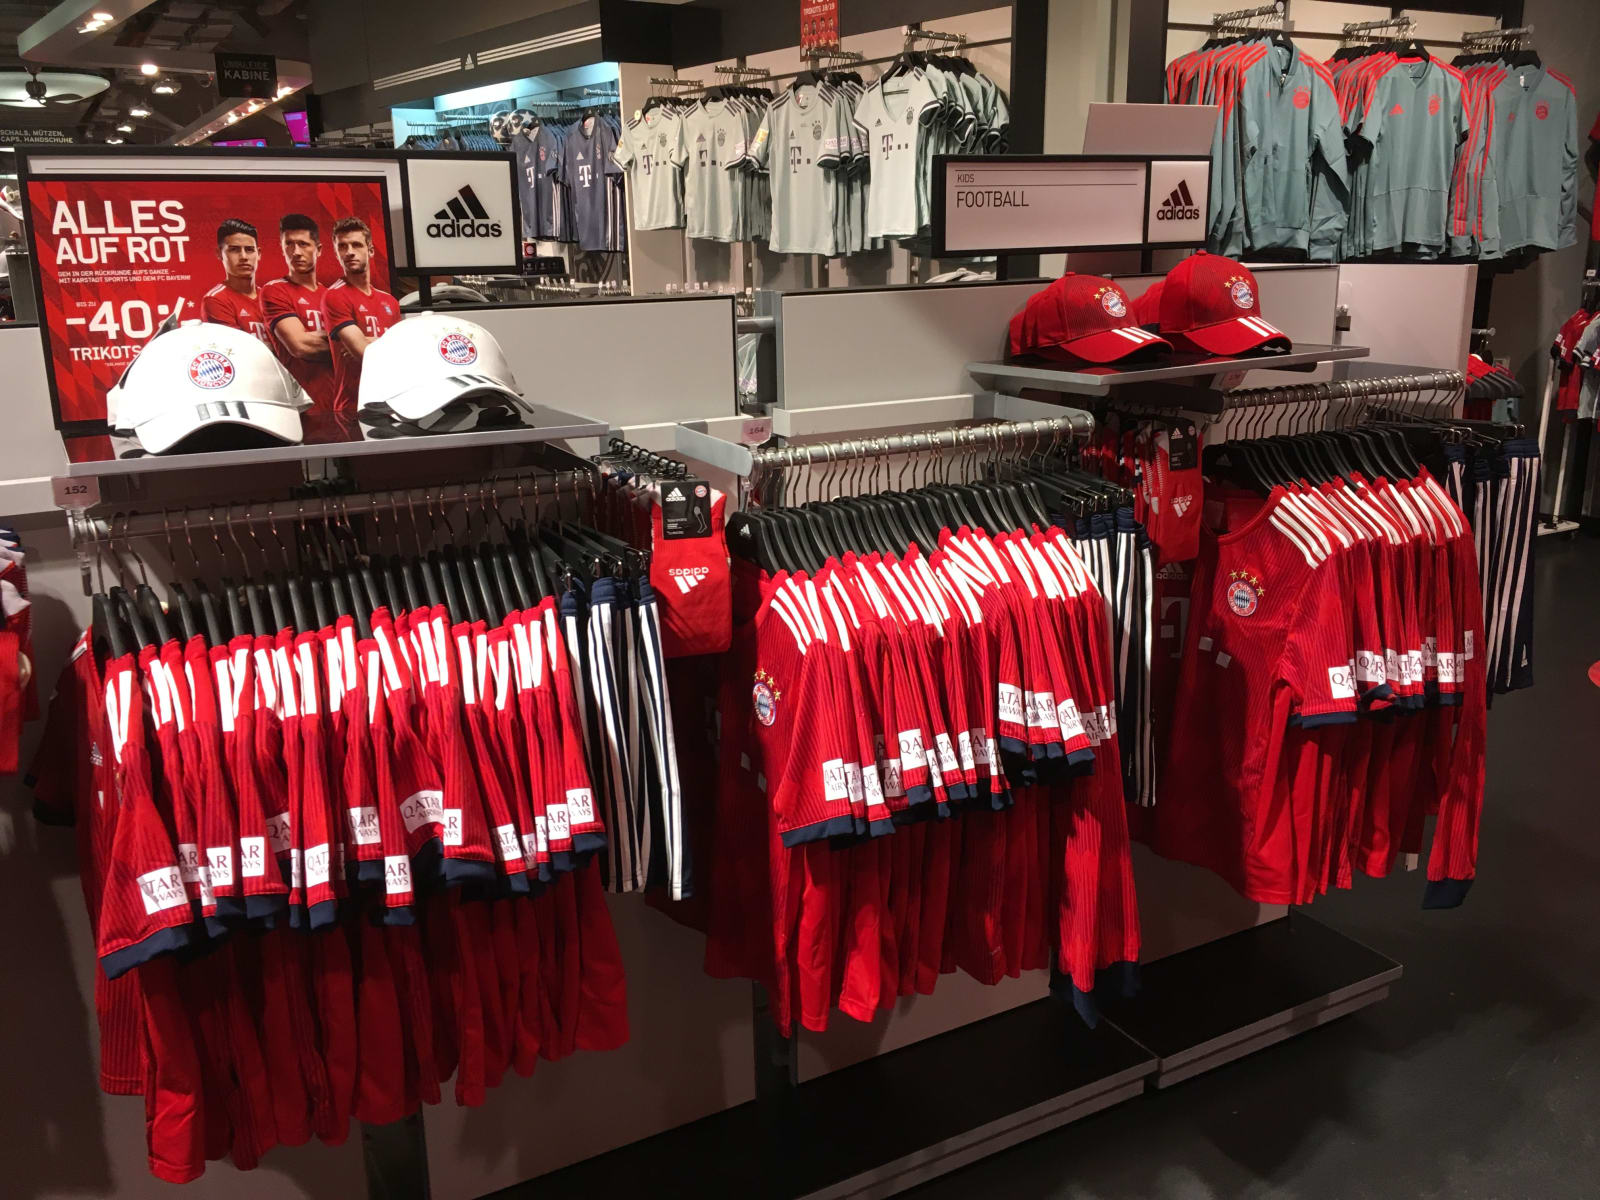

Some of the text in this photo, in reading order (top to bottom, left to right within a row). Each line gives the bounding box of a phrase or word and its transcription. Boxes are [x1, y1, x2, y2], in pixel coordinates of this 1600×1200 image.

[224, 69, 270, 80] KABINE
[32, 129, 65, 137] MÜTZEN,
[957, 174, 975, 183] KIDS
[956, 190, 1030, 208] FOOTBALL
[52, 200, 187, 235] ALLES
[1156, 205, 1200, 221] adidas
[426, 218, 502, 238] adidas
[56, 236, 190, 265] AUF ROT
[70, 345, 141, 361] TRIKOTS
[64, 485, 88, 495] 152
[668, 566, 710, 577] adidas
